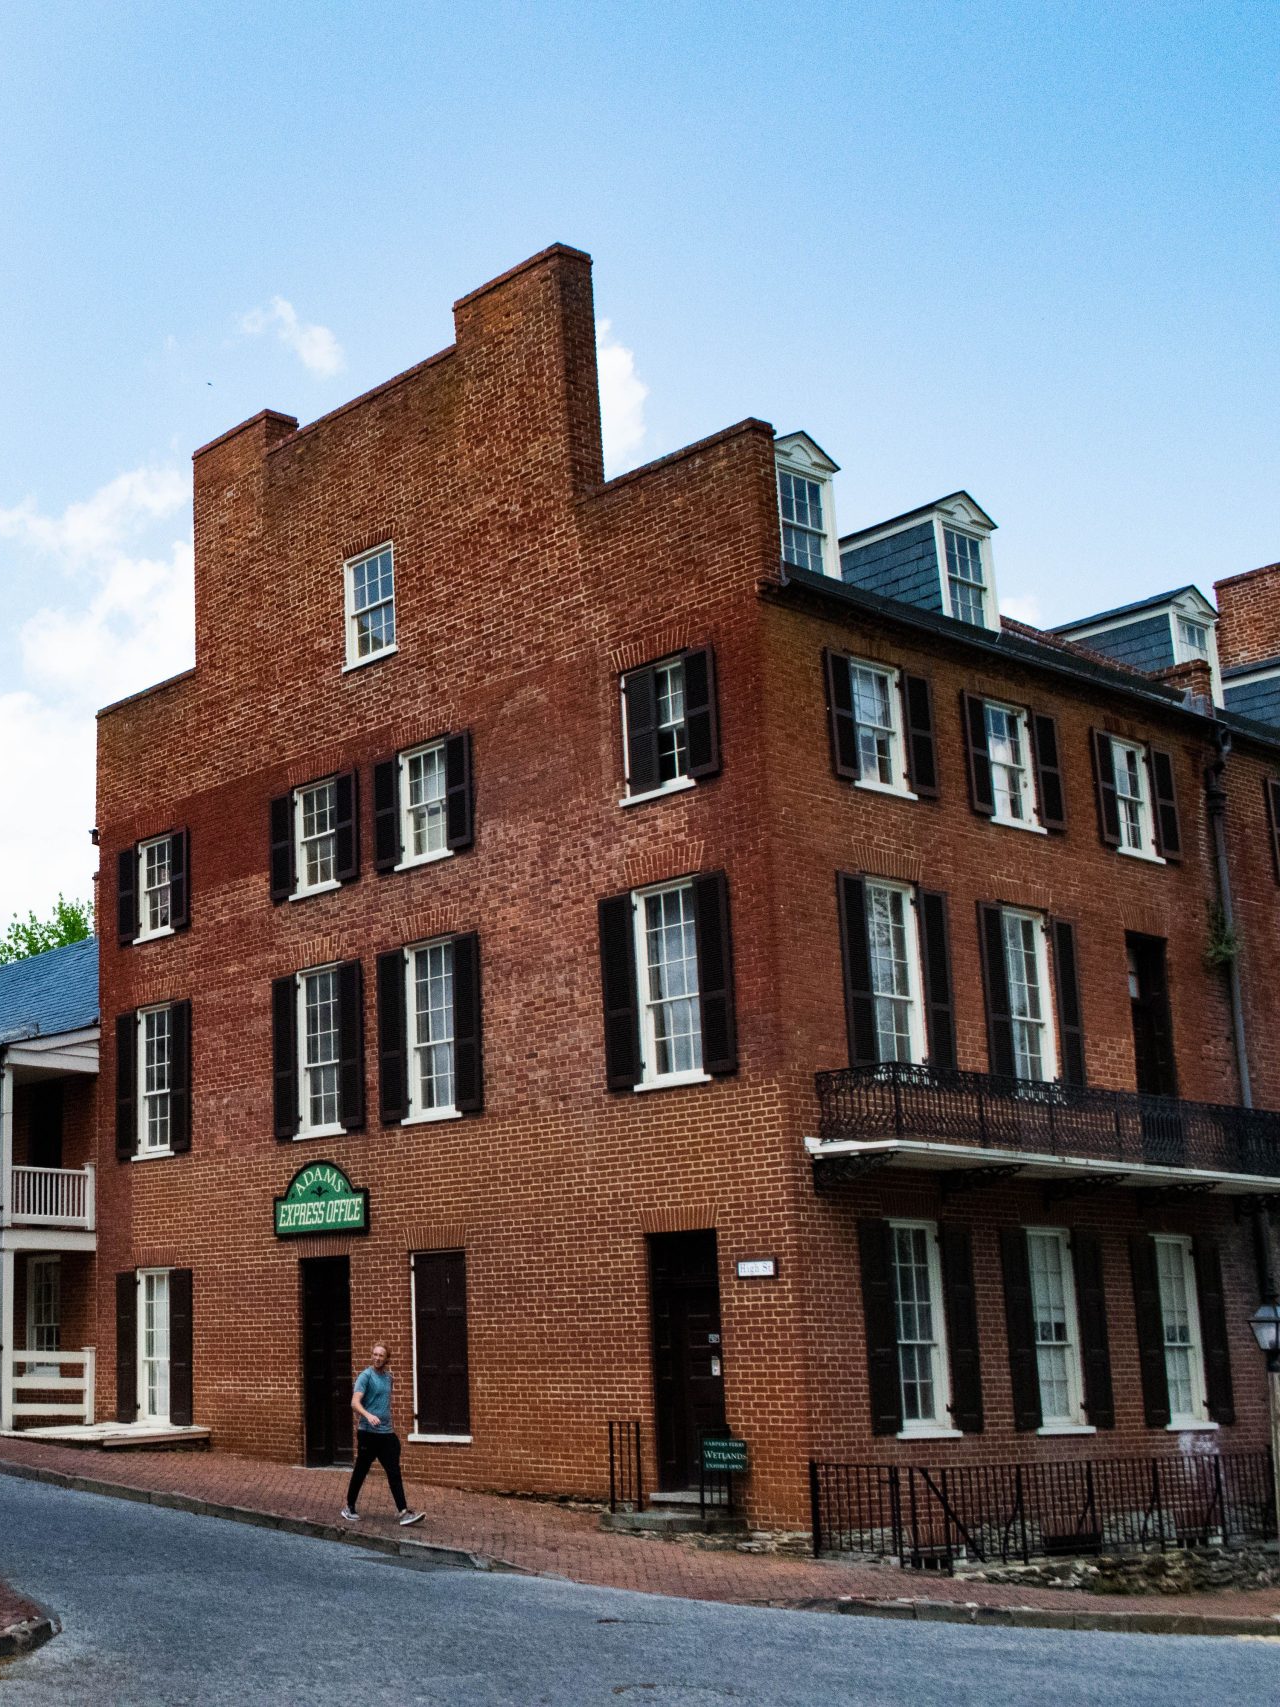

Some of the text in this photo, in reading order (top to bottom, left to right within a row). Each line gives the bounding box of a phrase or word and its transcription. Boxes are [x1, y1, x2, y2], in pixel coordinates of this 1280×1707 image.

[295, 1167, 344, 1197] ADAMS
[279, 1197, 362, 1227] EXPRESS OFFICE
[740, 1263, 760, 1275] High
